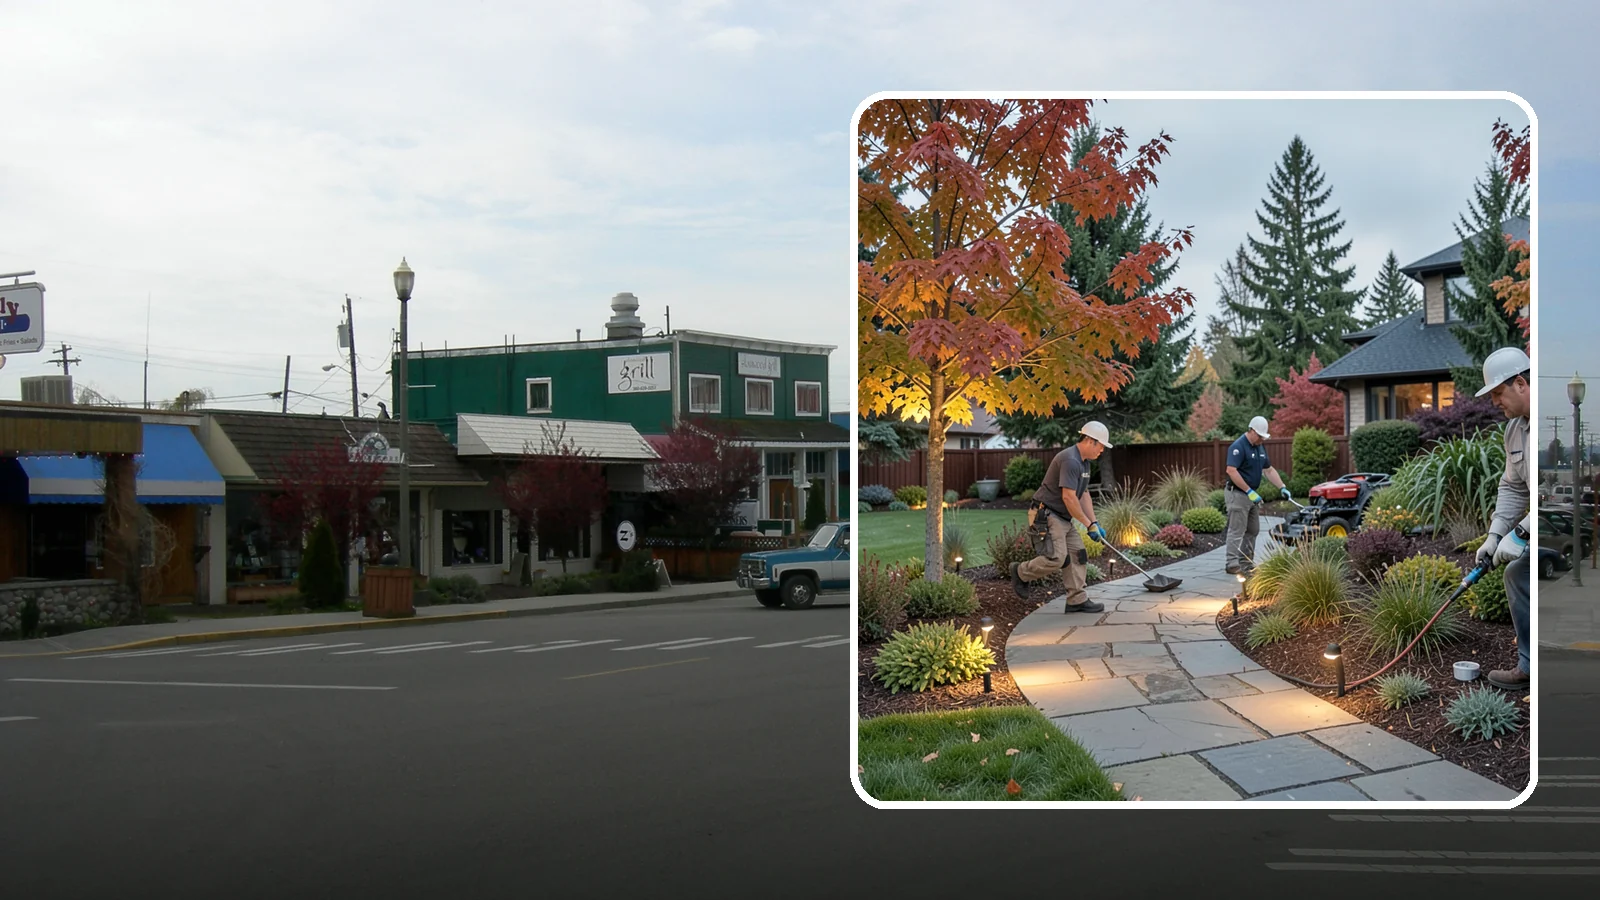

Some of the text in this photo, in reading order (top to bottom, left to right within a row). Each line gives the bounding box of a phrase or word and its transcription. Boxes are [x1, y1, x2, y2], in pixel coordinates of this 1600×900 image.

[3, 336, 38, 346] Fries Salads
[617, 356, 655, 392] grill
